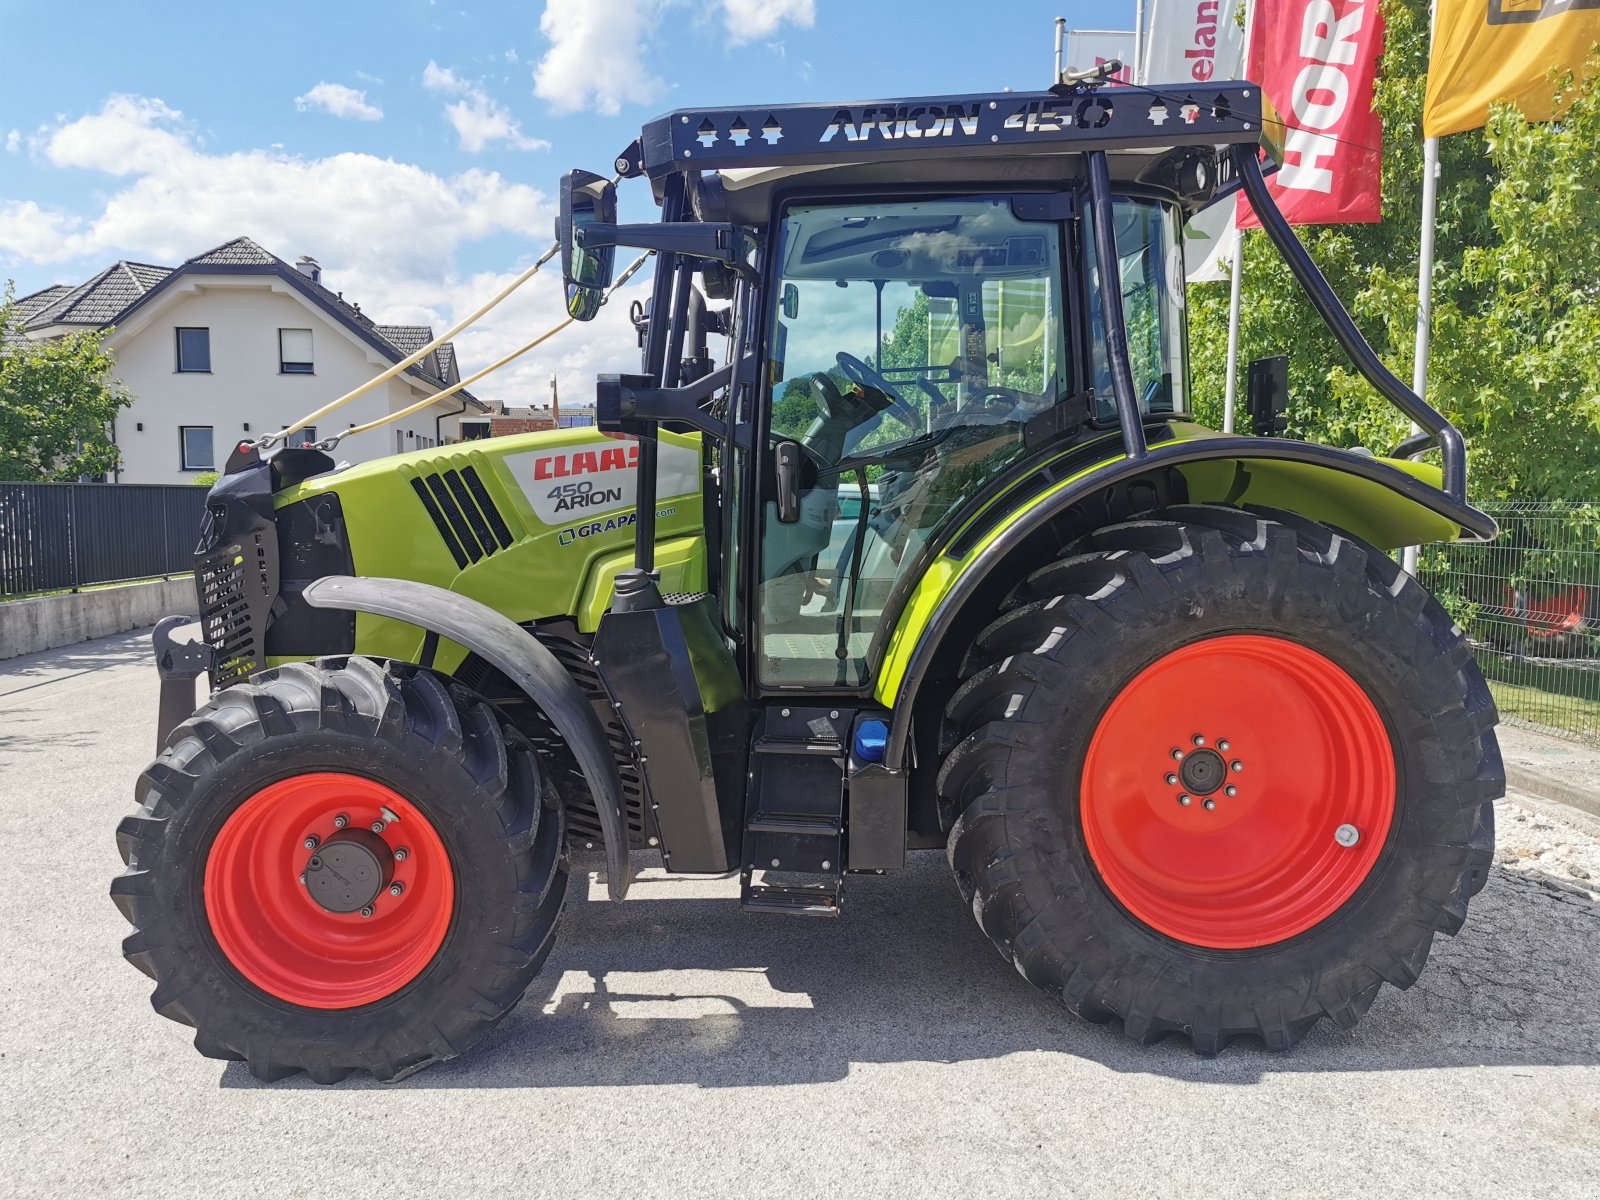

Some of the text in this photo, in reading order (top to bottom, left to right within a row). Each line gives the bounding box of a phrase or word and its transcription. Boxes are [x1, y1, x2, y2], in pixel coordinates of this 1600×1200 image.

[1184, 0, 1219, 82] elan
[1276, 0, 1366, 194] HOR
[818, 97, 1115, 143] ARION 450
[547, 481, 593, 499] 450
[554, 487, 622, 513] ARION
[578, 513, 637, 538] GRAPA
